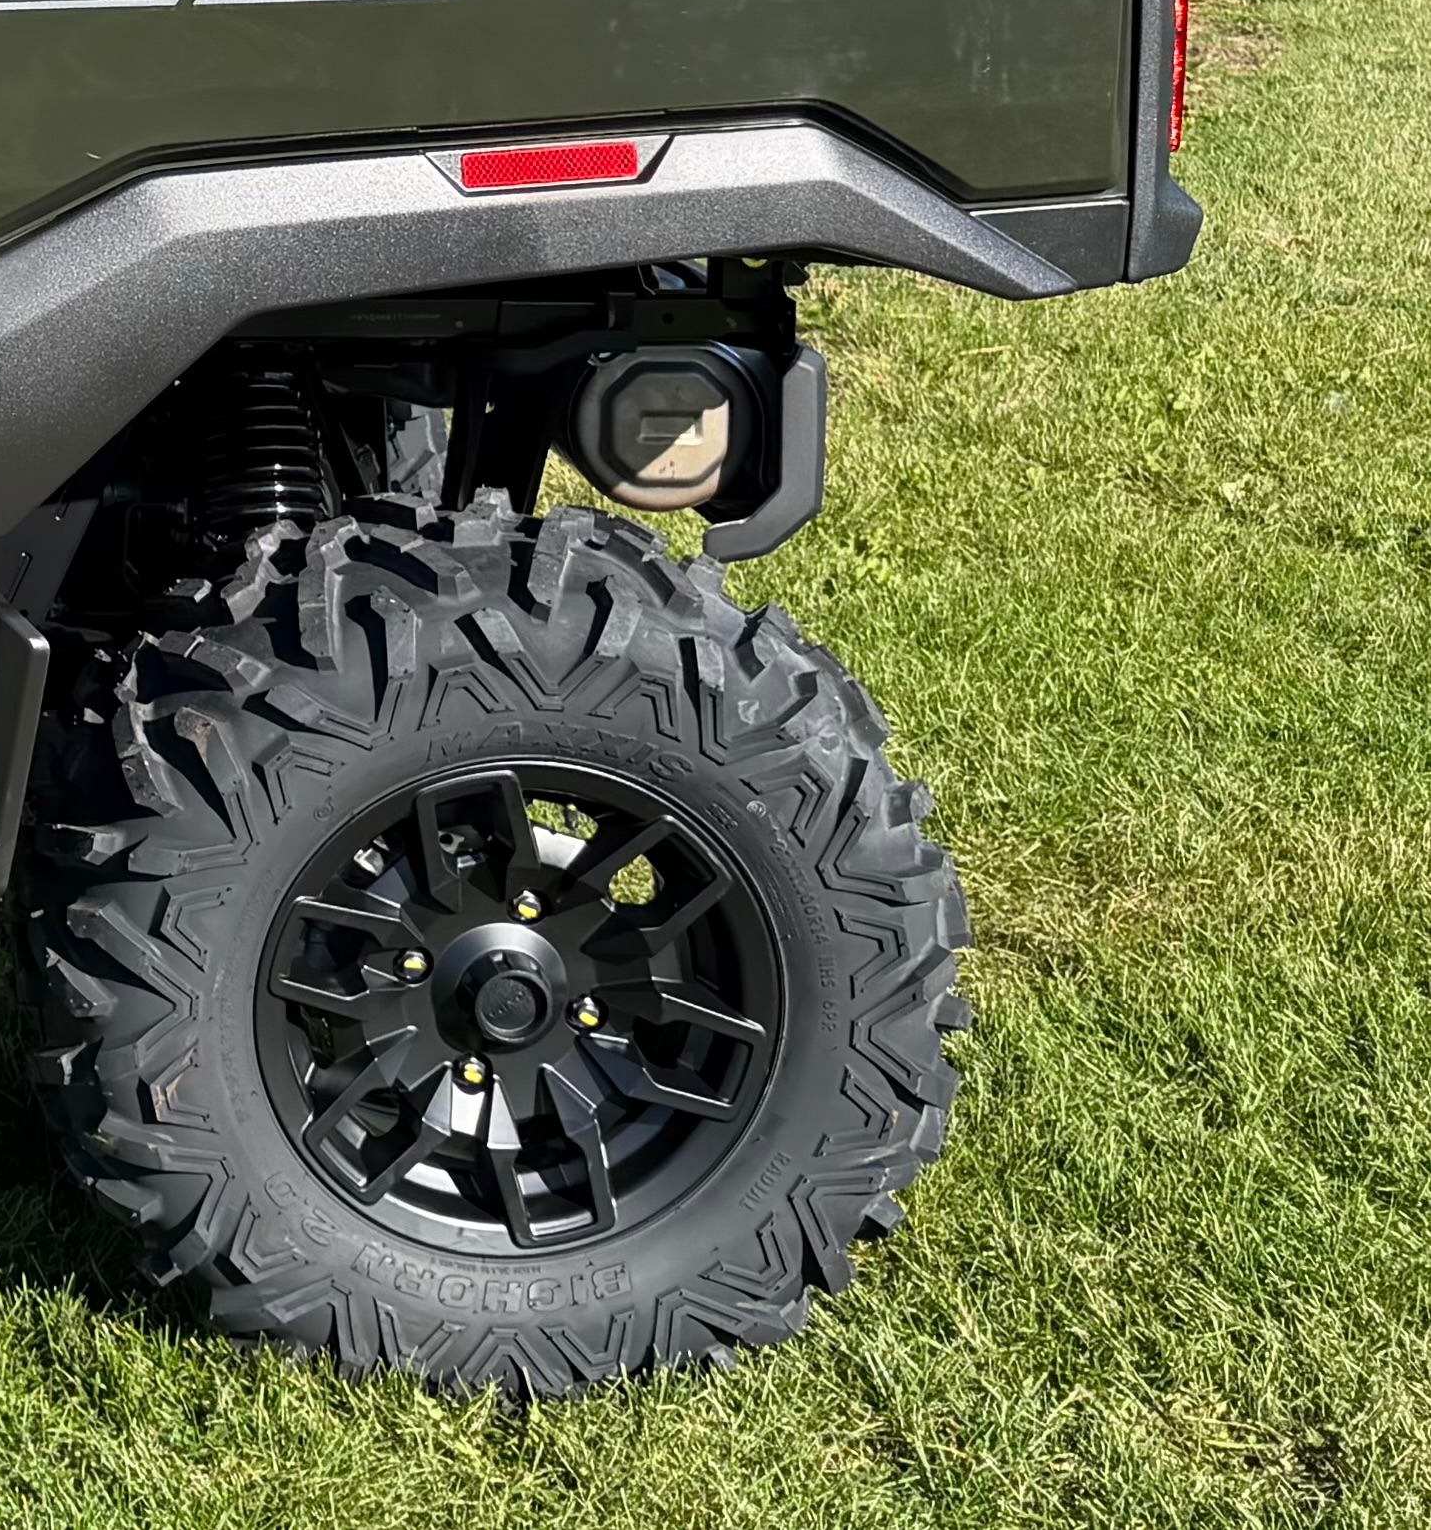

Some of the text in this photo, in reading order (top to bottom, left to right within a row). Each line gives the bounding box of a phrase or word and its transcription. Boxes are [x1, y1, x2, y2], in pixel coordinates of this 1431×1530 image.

[425, 720, 696, 782] MAXXIS
[738, 1150, 793, 1213] RADIAL
[263, 1172, 632, 1314] BIGHORN 2.0
